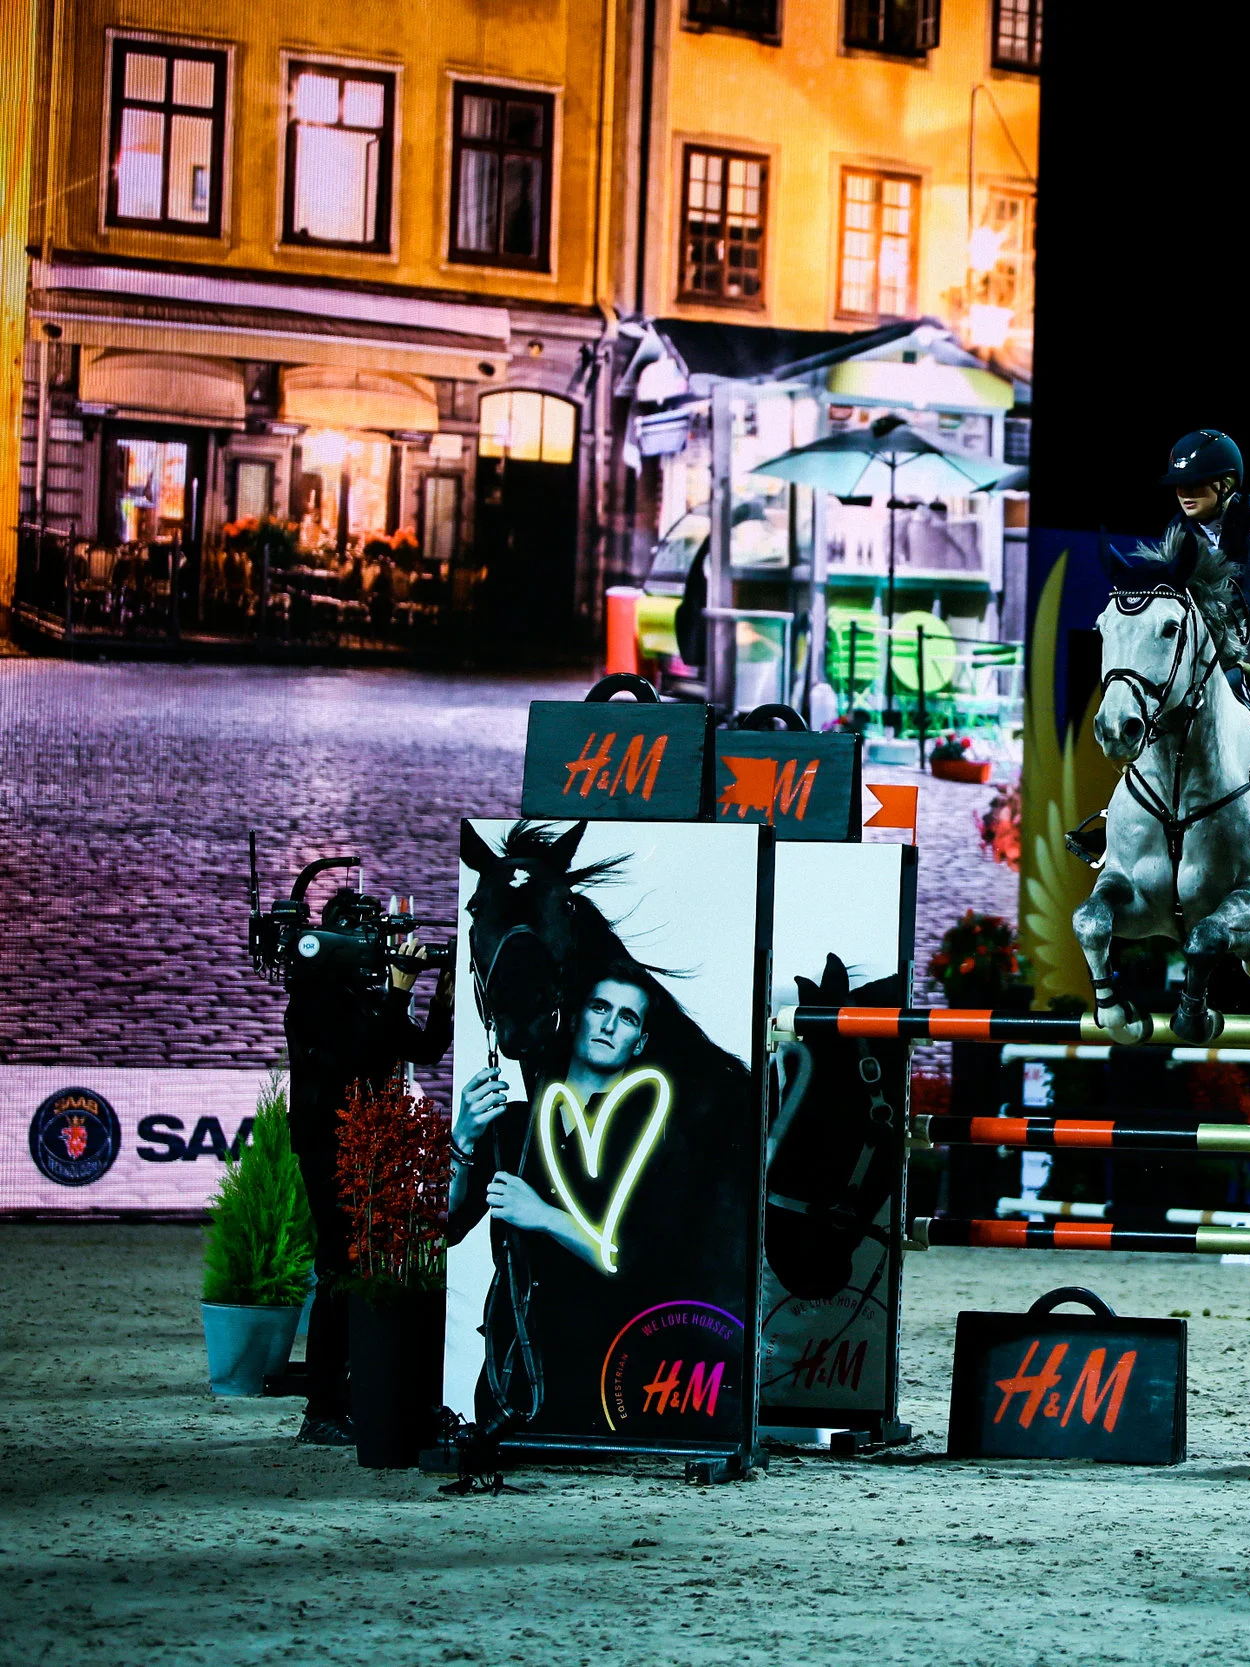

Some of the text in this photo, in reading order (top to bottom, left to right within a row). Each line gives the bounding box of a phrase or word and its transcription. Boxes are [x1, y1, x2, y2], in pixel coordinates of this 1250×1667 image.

[562, 732, 668, 800] H&M
[136, 1113, 256, 1163] SA
[641, 1312, 734, 1340] WE LOVE HORSES
[790, 1303, 807, 1317] WE
[837, 1295, 876, 1320] HORES
[614, 1353, 629, 1419] EQUESTRIAN
[643, 1359, 725, 1417] H&M
[792, 1338, 868, 1392] H&M
[994, 1340, 1137, 1433] H&M
